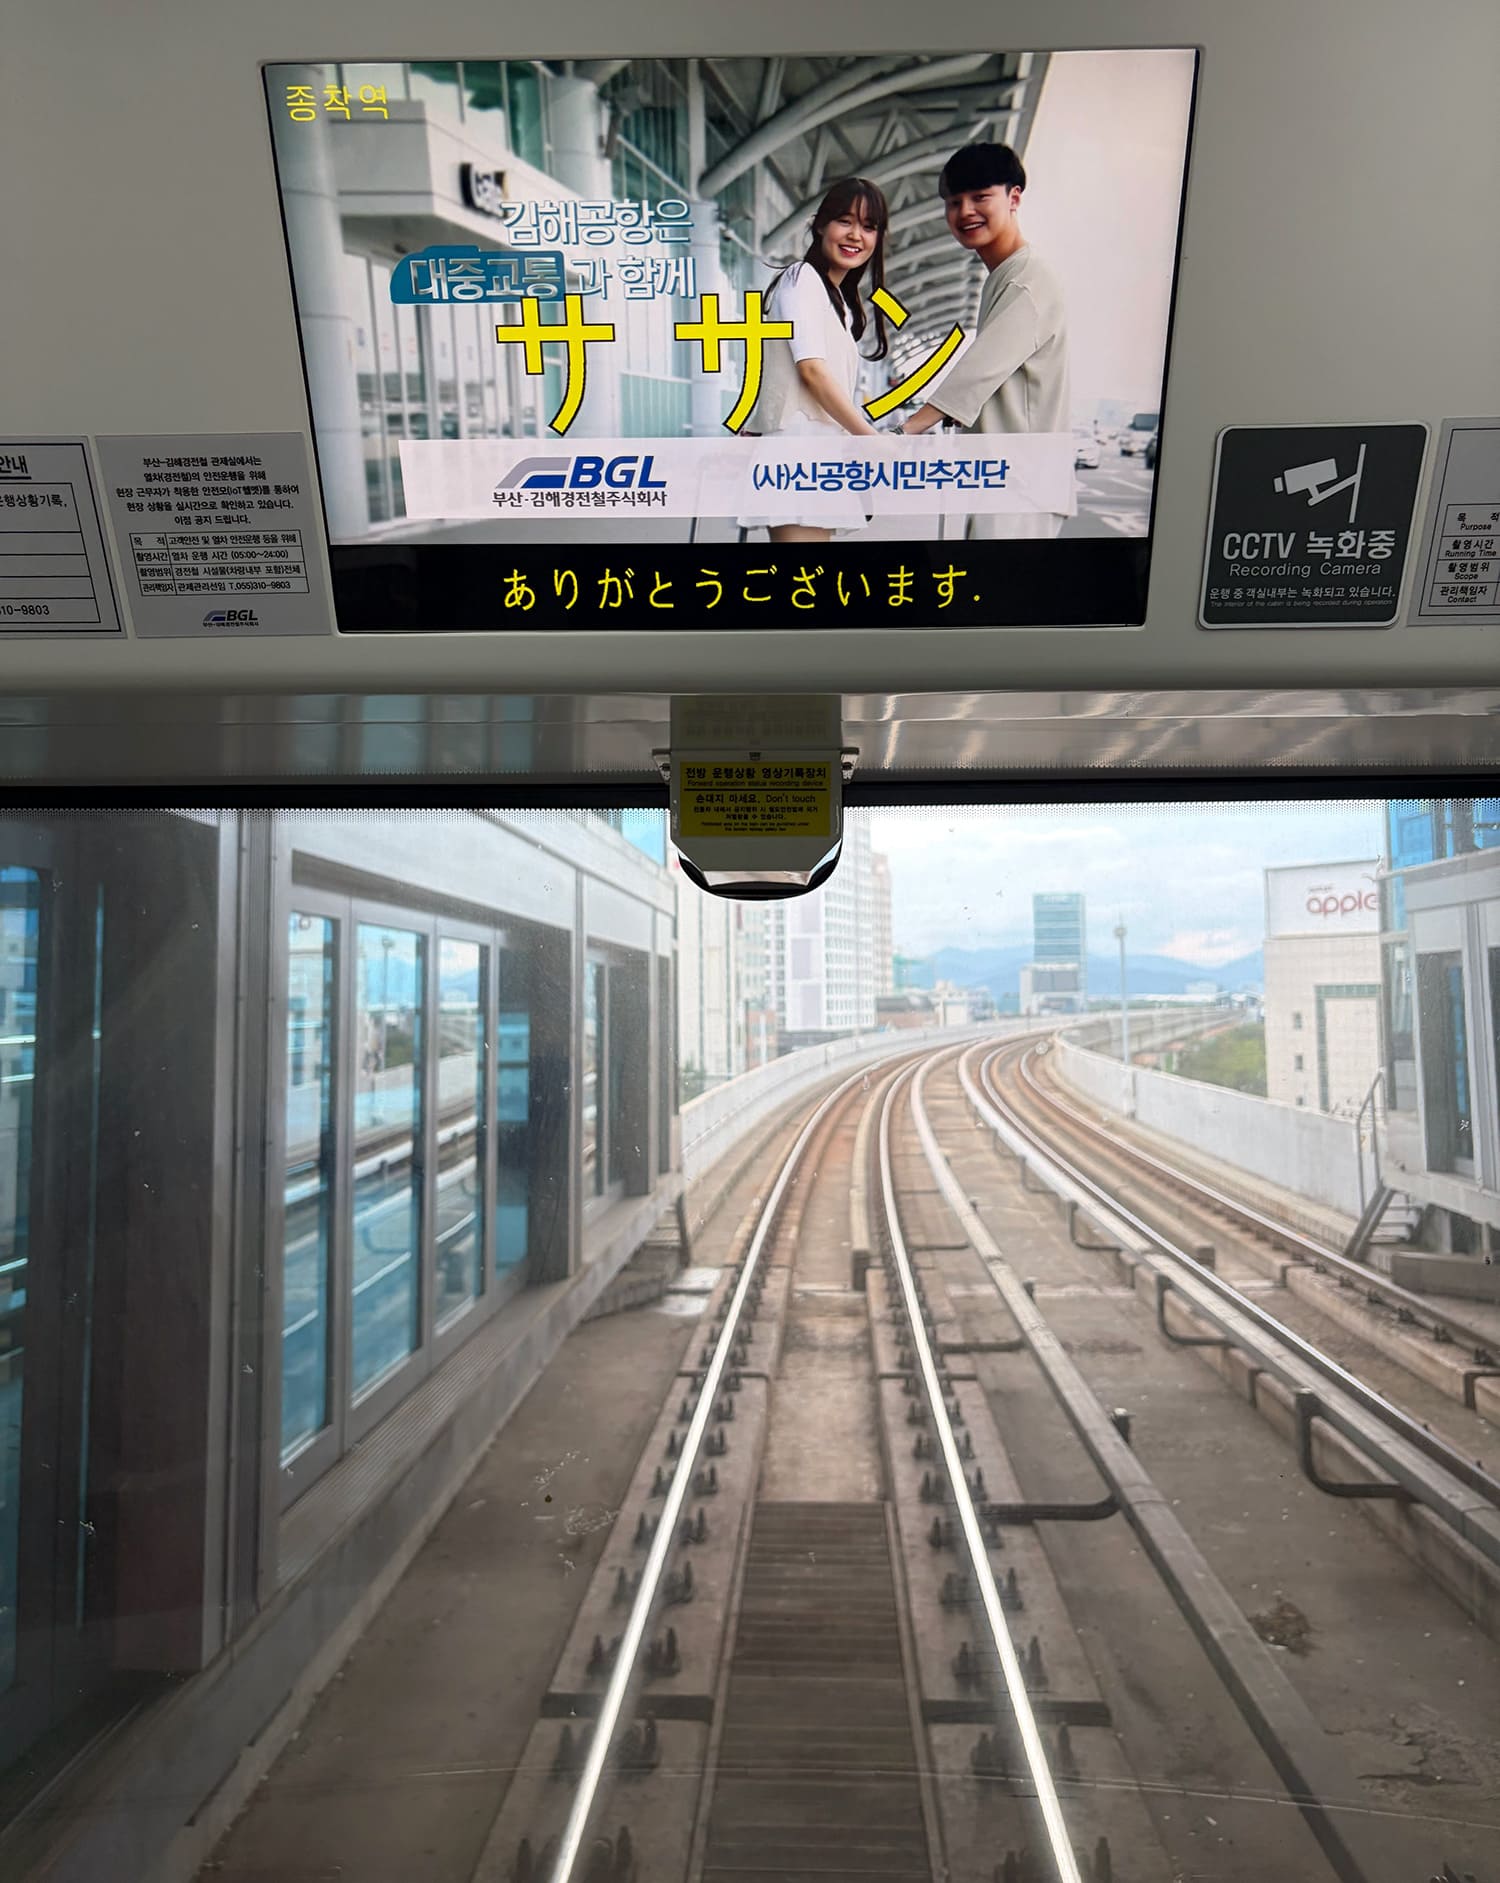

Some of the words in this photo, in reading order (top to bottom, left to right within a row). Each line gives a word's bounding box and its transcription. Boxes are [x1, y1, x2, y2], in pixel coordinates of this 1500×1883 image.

[286, 83, 389, 121] 종착역
[501, 198, 693, 245] 김해공항은
[409, 256, 562, 301] 대중교통
[618, 257, 696, 300] 함께
[496, 289, 966, 436] ササン
[249, 470, 267, 481] 위해
[567, 455, 668, 489] BGL
[751, 459, 1011, 492] (사)신공항시민추진단
[116, 487, 133, 498] 현장
[136, 487, 171, 498] 근무자가
[491, 490, 668, 509] 부산-김해경전철주식회사
[0, 494, 68, 508] 행상황기록,
[126, 502, 144, 513] 현장
[176, 501, 218, 512] 실시간으로
[257, 499, 294, 510] 있습니다.
[174, 516, 192, 526] 이점
[194, 515, 212, 526] 공지
[215, 514, 252, 525] 드립니다.
[1460, 523, 1492, 532] Purpose
[1222, 532, 1297, 560] CCTV
[1306, 530, 1396, 560] 녹화중
[211, 550, 228, 560] 시간
[1445, 550, 1476, 559] Running
[1479, 549, 1497, 558] Time
[1229, 562, 1312, 578] Recording
[1319, 561, 1381, 576] Camera
[1454, 573, 1479, 581] Scope
[1209, 588, 1231, 600] 운행
[1233, 588, 1243, 600] 중
[1246, 587, 1298, 600] 객실내부는
[1301, 586, 1345, 599] 녹화되고
[1349, 585, 1396, 598] 있습니다.
[1447, 595, 1477, 604] Contact
[0, 604, 50, 616] 10-9803
[227, 609, 259, 621] BGL
[765, 793, 789, 804] Don't
[791, 794, 816, 804] touch
